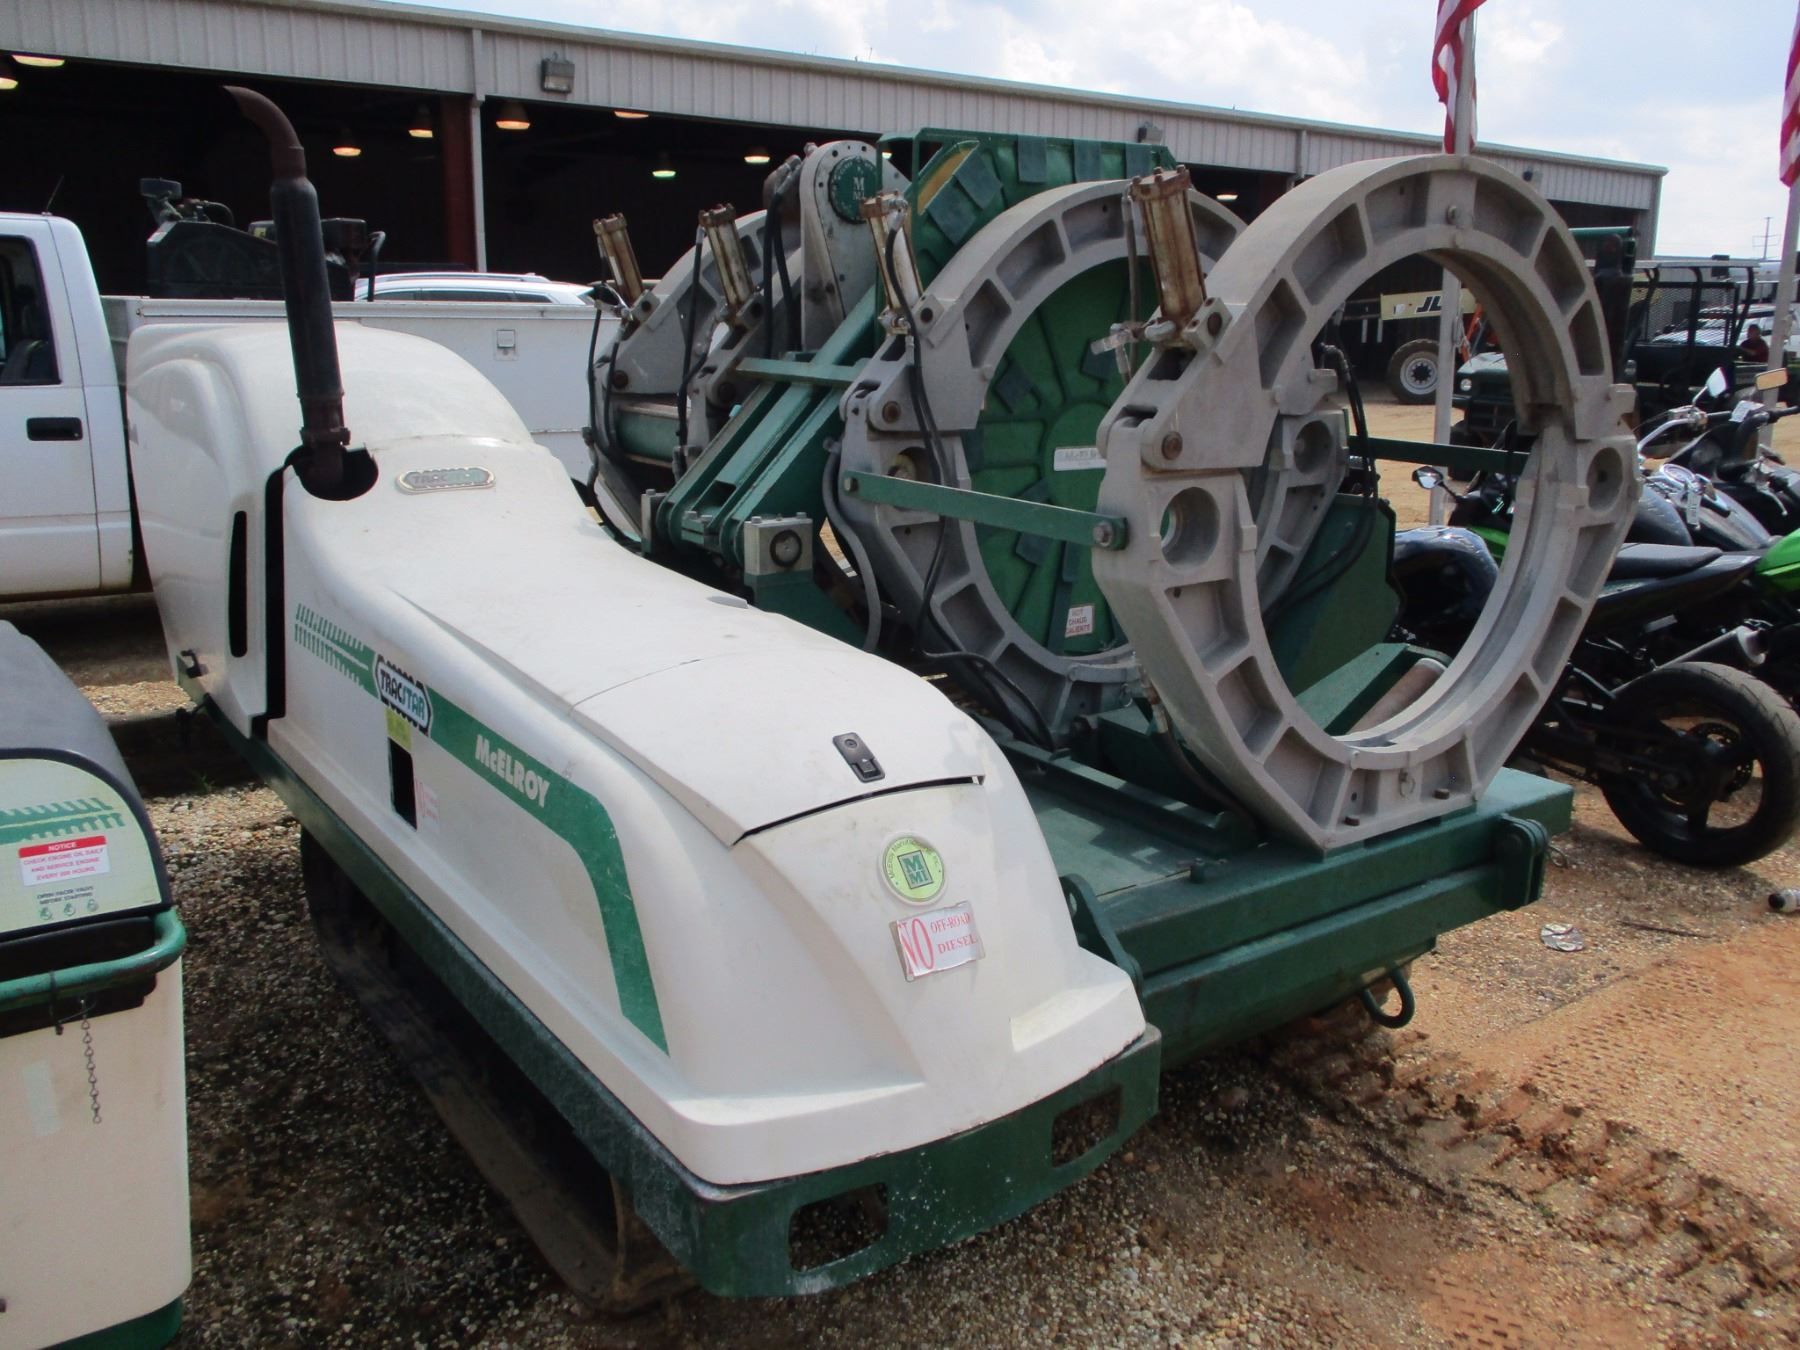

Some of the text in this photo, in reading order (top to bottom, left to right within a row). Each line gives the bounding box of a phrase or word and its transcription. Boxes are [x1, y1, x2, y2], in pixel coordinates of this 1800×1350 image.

[1416, 296, 1441, 313] JL
[380, 669, 425, 721] TRACSTAR
[475, 734, 551, 808] McELROY
[48, 841, 77, 852] NOTICE
[930, 912, 972, 934] OFF-ROAD
[937, 933, 978, 954] DIESEL
